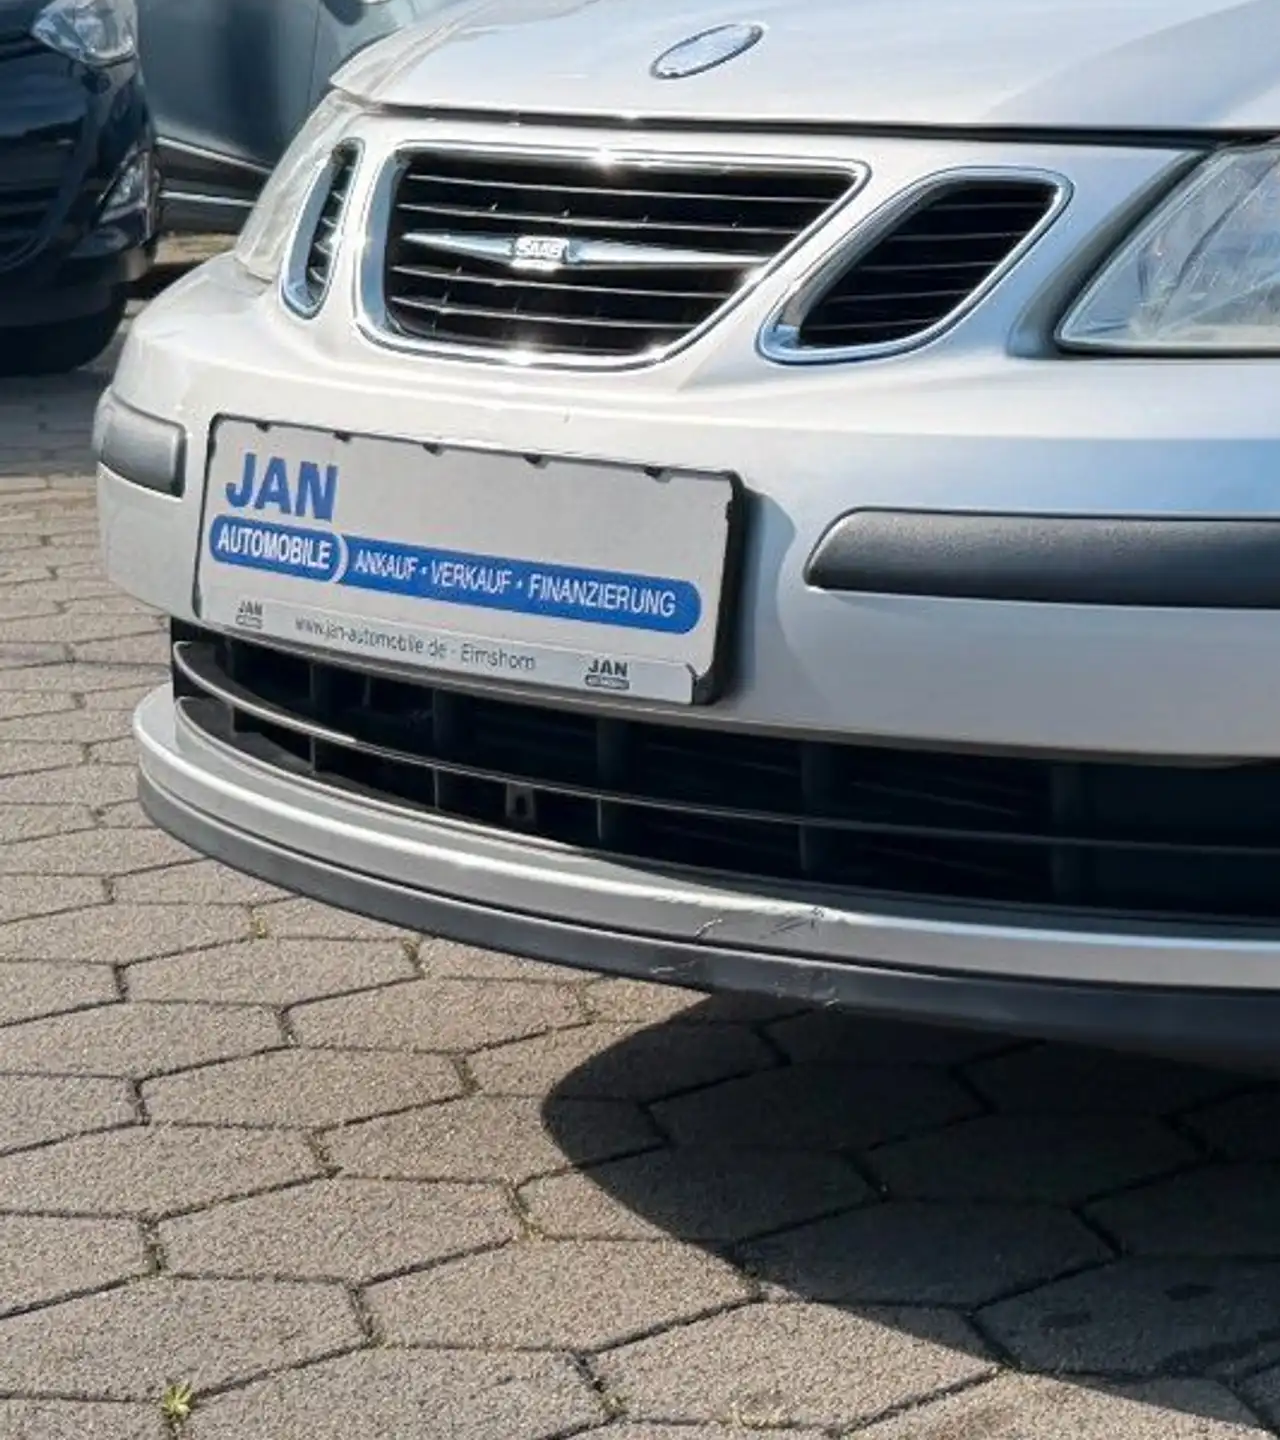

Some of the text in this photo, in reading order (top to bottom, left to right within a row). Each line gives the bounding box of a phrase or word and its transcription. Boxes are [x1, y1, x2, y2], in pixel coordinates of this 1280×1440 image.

[225, 452, 338, 521] JAN
[218, 523, 333, 570] AUTOMOBILE
[354, 550, 676, 617] ANKAUF VERKAUF FINANZIERUNG
[460, 643, 536, 671] Elmshorn
[588, 658, 628, 677] JAN
